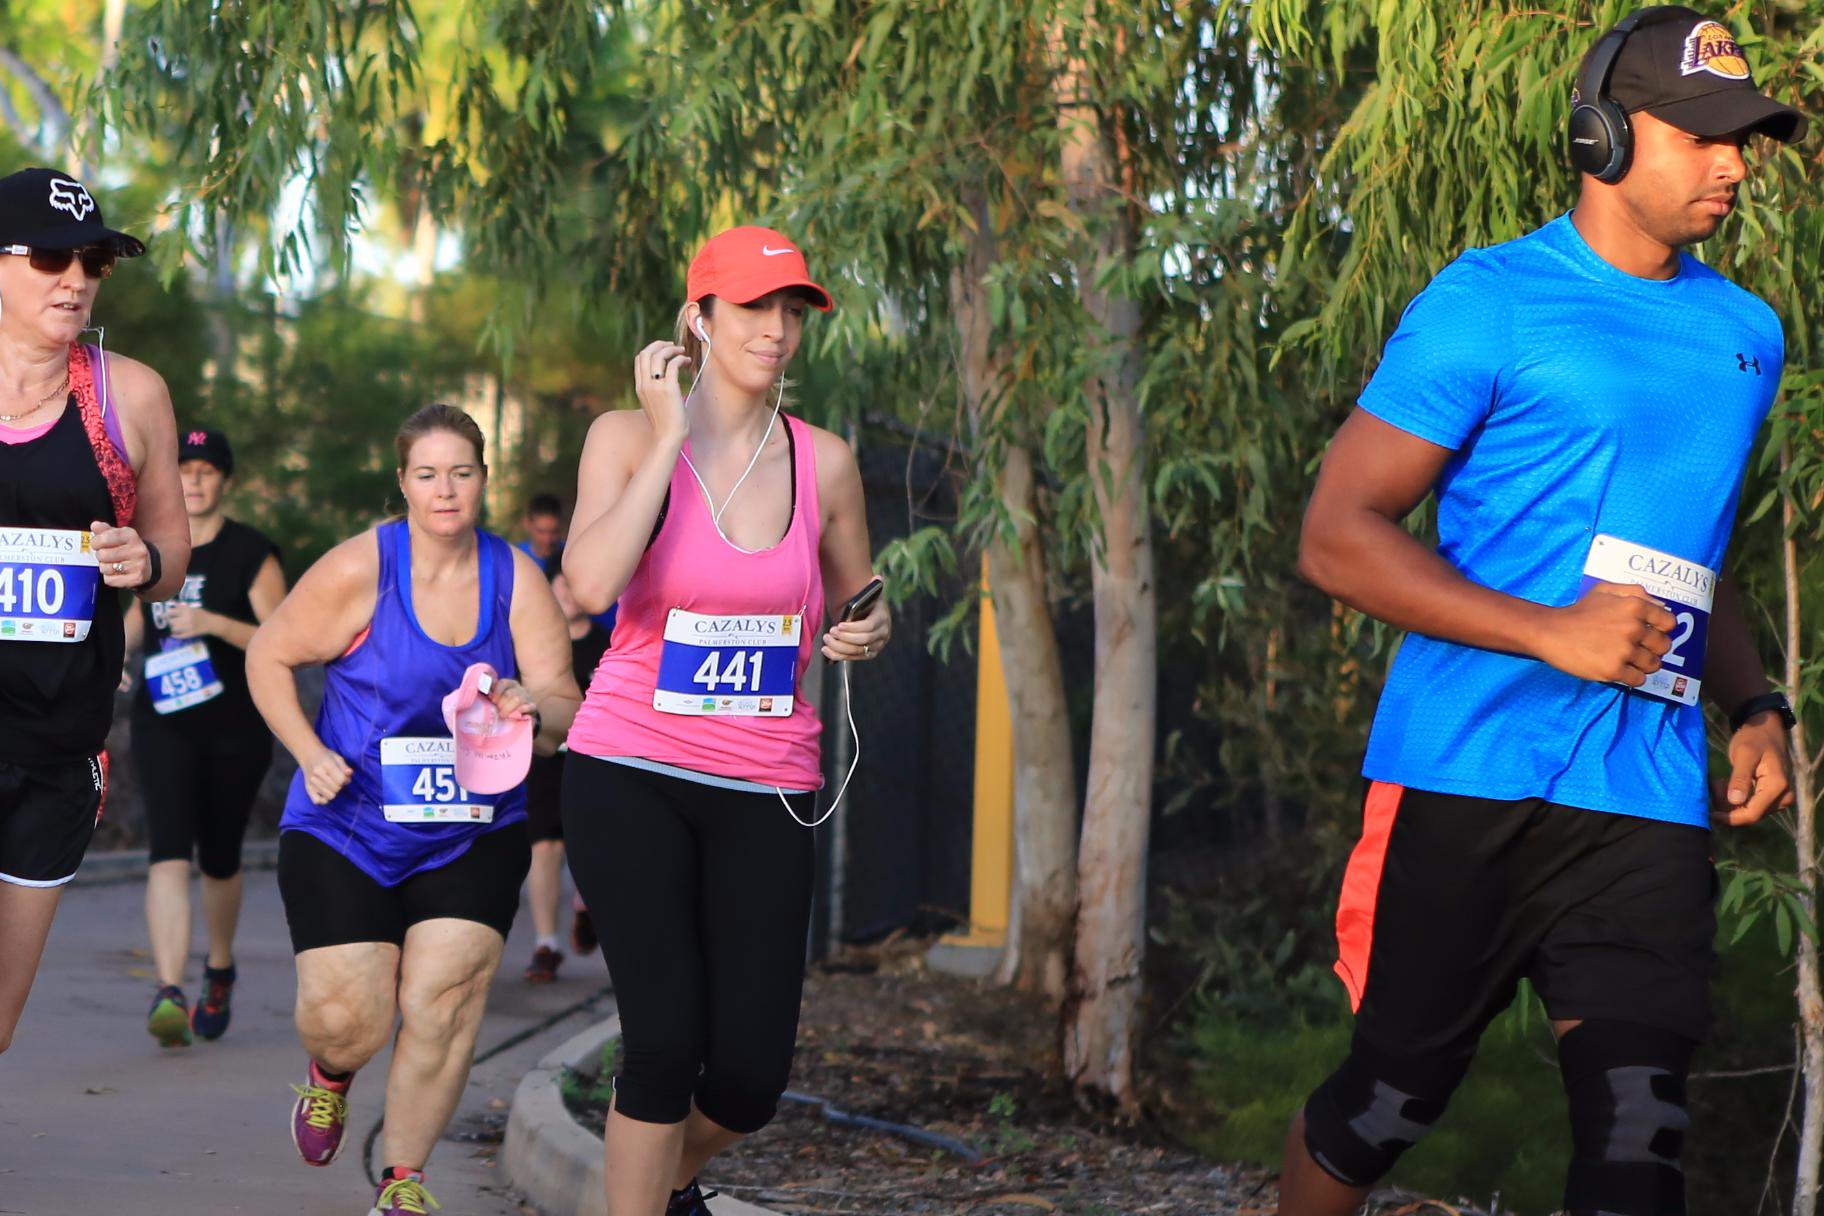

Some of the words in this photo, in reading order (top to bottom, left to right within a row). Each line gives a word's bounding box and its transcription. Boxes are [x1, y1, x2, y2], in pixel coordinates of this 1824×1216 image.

[1628, 554, 1709, 592] CAZALYS
[695, 619, 775, 634] CAZALYS
[160, 666, 202, 697] 458
[693, 651, 763, 692] 441
[405, 742, 455, 753] CAZAL
